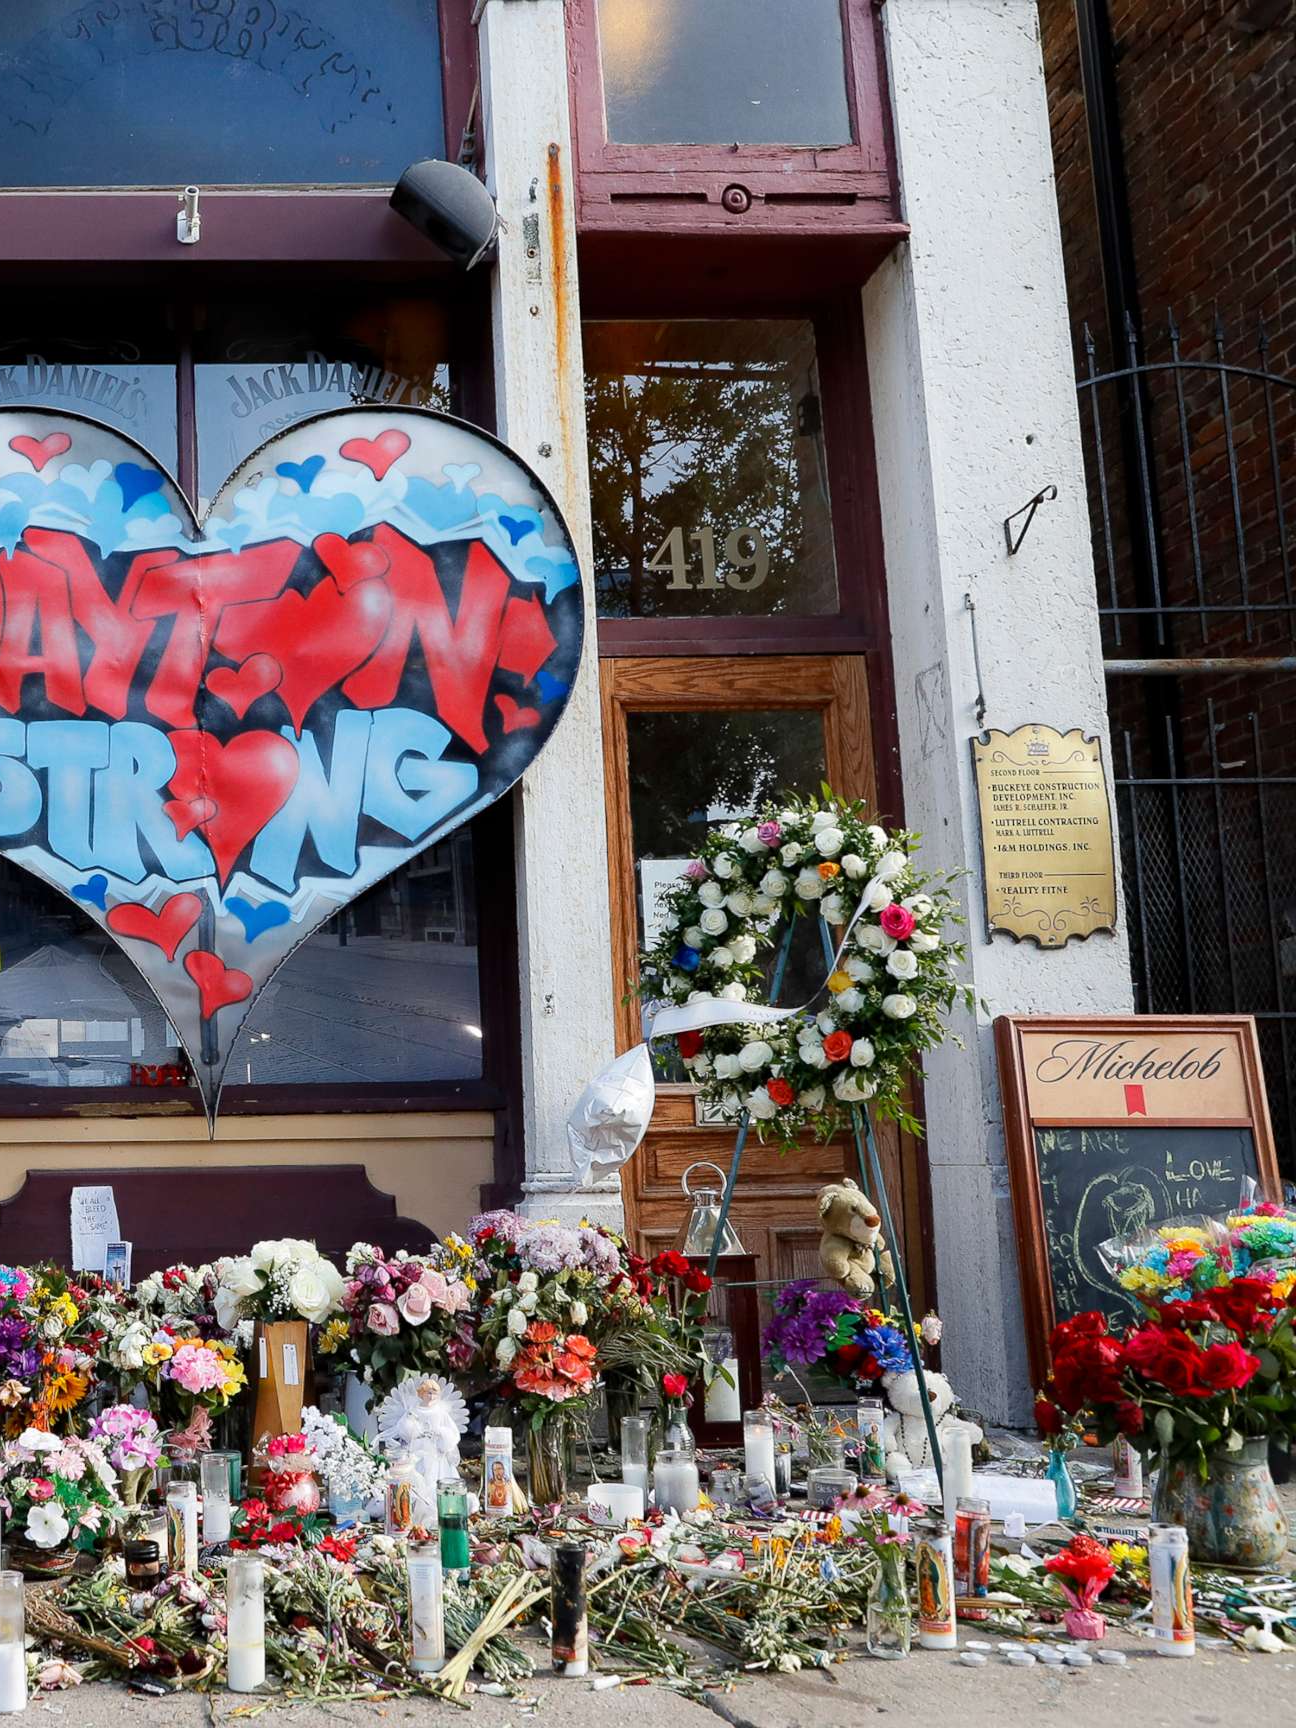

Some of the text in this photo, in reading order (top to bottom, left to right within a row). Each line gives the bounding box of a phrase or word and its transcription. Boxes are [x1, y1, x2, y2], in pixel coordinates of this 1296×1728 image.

[226, 363, 304, 418] JACK
[645, 526, 770, 590] 419
[990, 769, 1017, 777] SECOND
[992, 782, 1100, 792] BUCKEYE CONSTRUCTION
[995, 817, 1099, 826] LUTTRELL CONTRACTING
[654, 881, 681, 889] Please
[1001, 886, 1039, 894] REALITY
[1035, 1040, 1228, 1084] Michelob
[1165, 1150, 1236, 1183] LOVE
